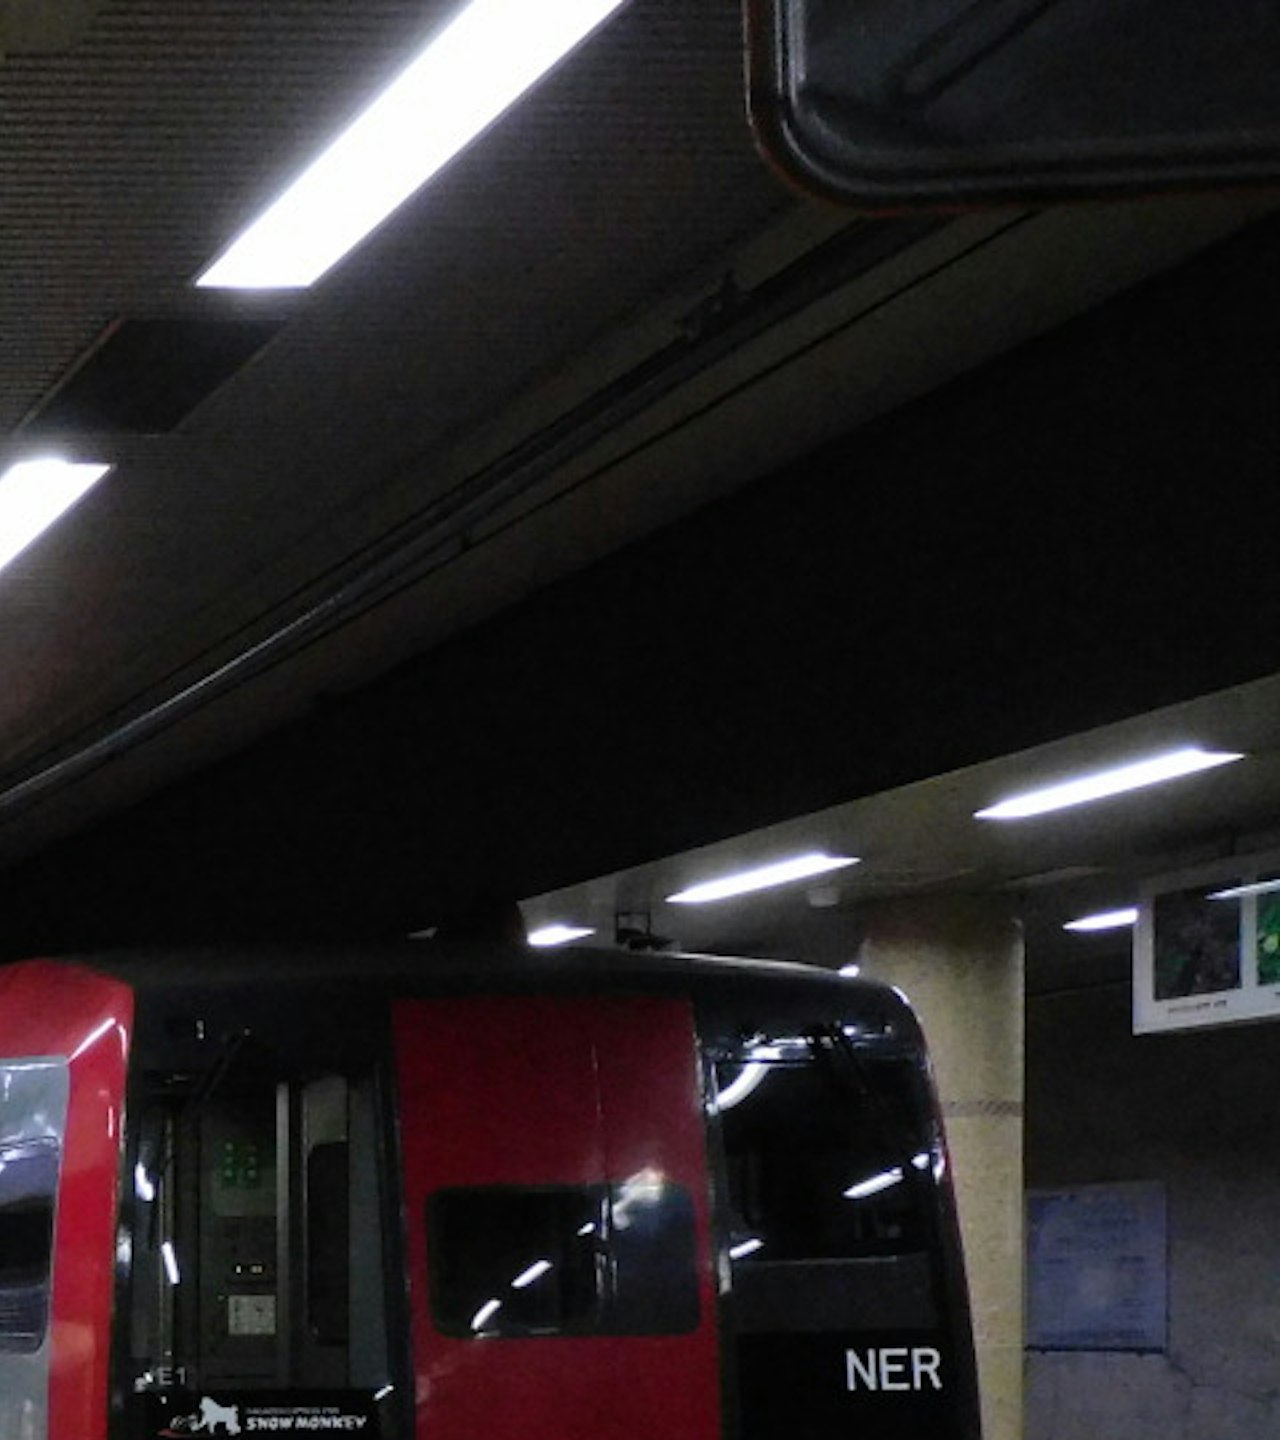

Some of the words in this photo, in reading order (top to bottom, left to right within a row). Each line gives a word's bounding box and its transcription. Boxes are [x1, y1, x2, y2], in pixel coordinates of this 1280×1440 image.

[845, 1347, 942, 1391] NER
[245, 1416, 294, 1431] SNOW
[295, 1415, 367, 1430] MONKEY
